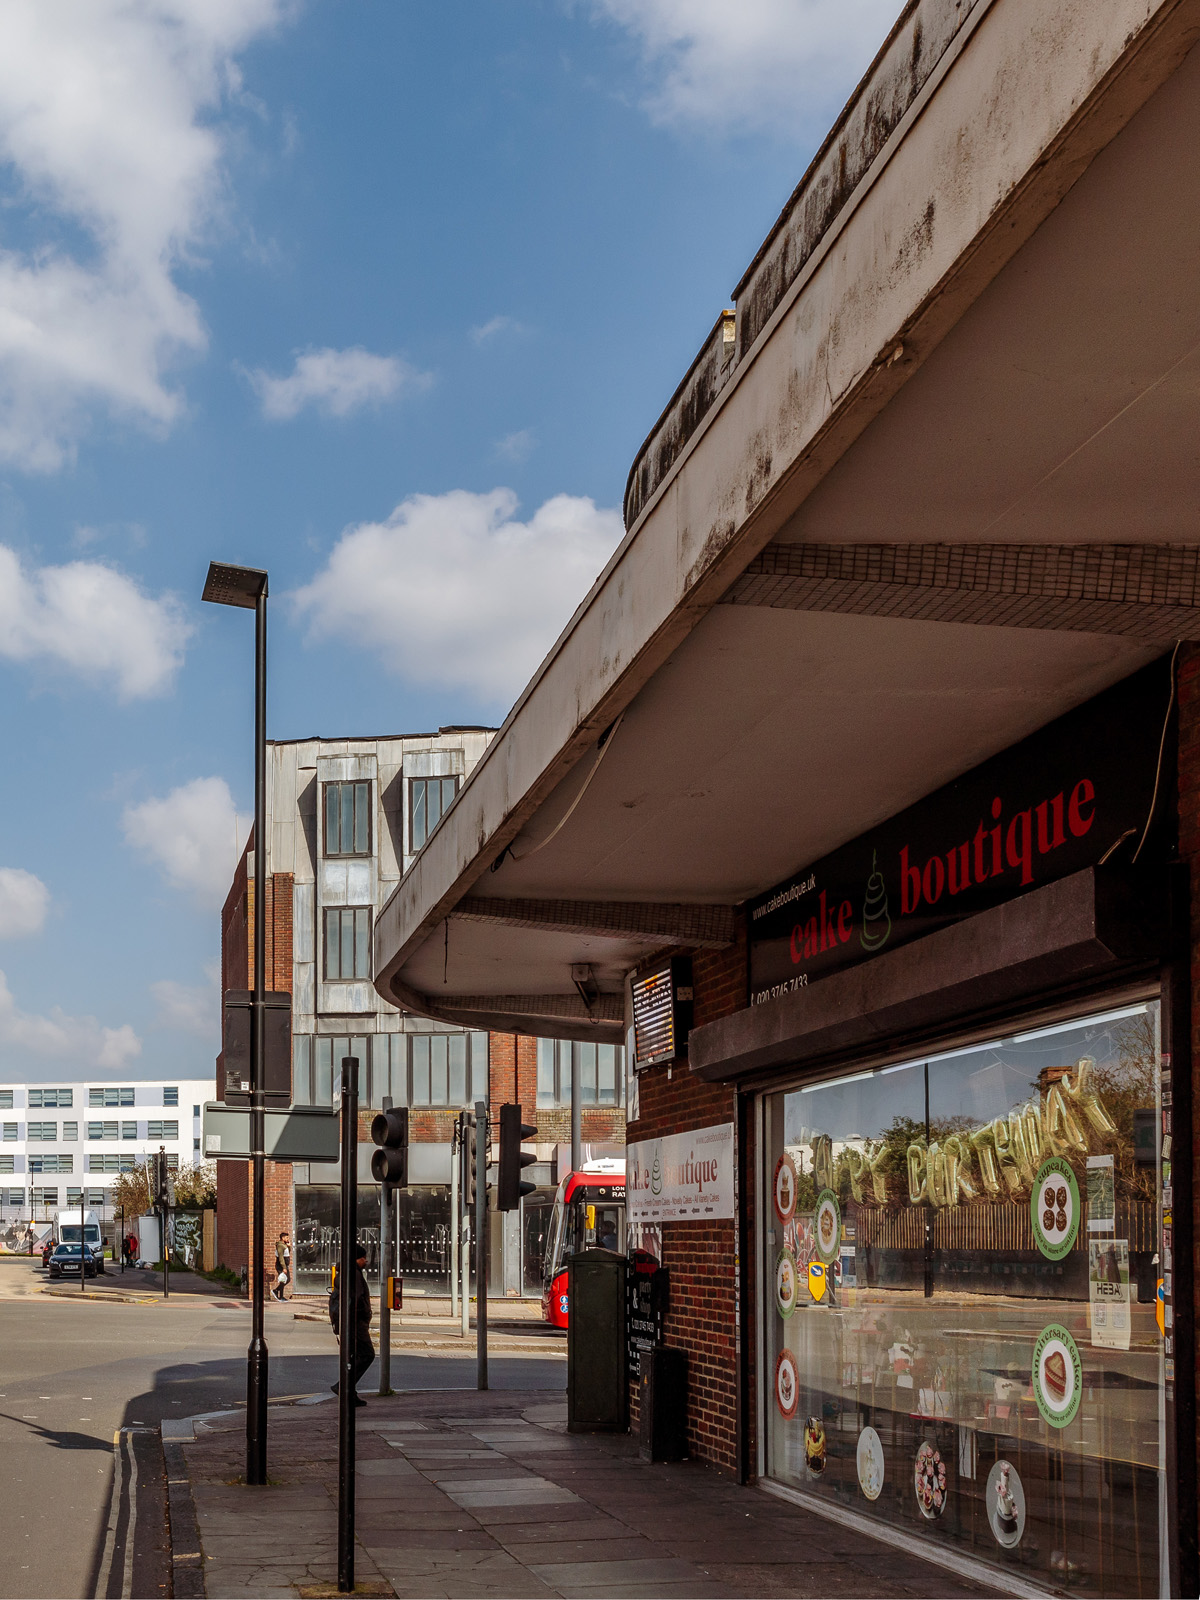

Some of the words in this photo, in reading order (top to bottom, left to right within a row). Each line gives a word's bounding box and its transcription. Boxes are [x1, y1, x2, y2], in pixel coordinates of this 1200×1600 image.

[899, 778, 1096, 917] boutique
[752, 873, 816, 920] www.cakeboutique.uk
[790, 889, 853, 964] cake
[663, 1150, 717, 1193] boutique
[1038, 1161, 1072, 1184] cupcakes
[1035, 1329, 1071, 1379] anniversary
[1069, 1346, 1081, 1391] cakes
